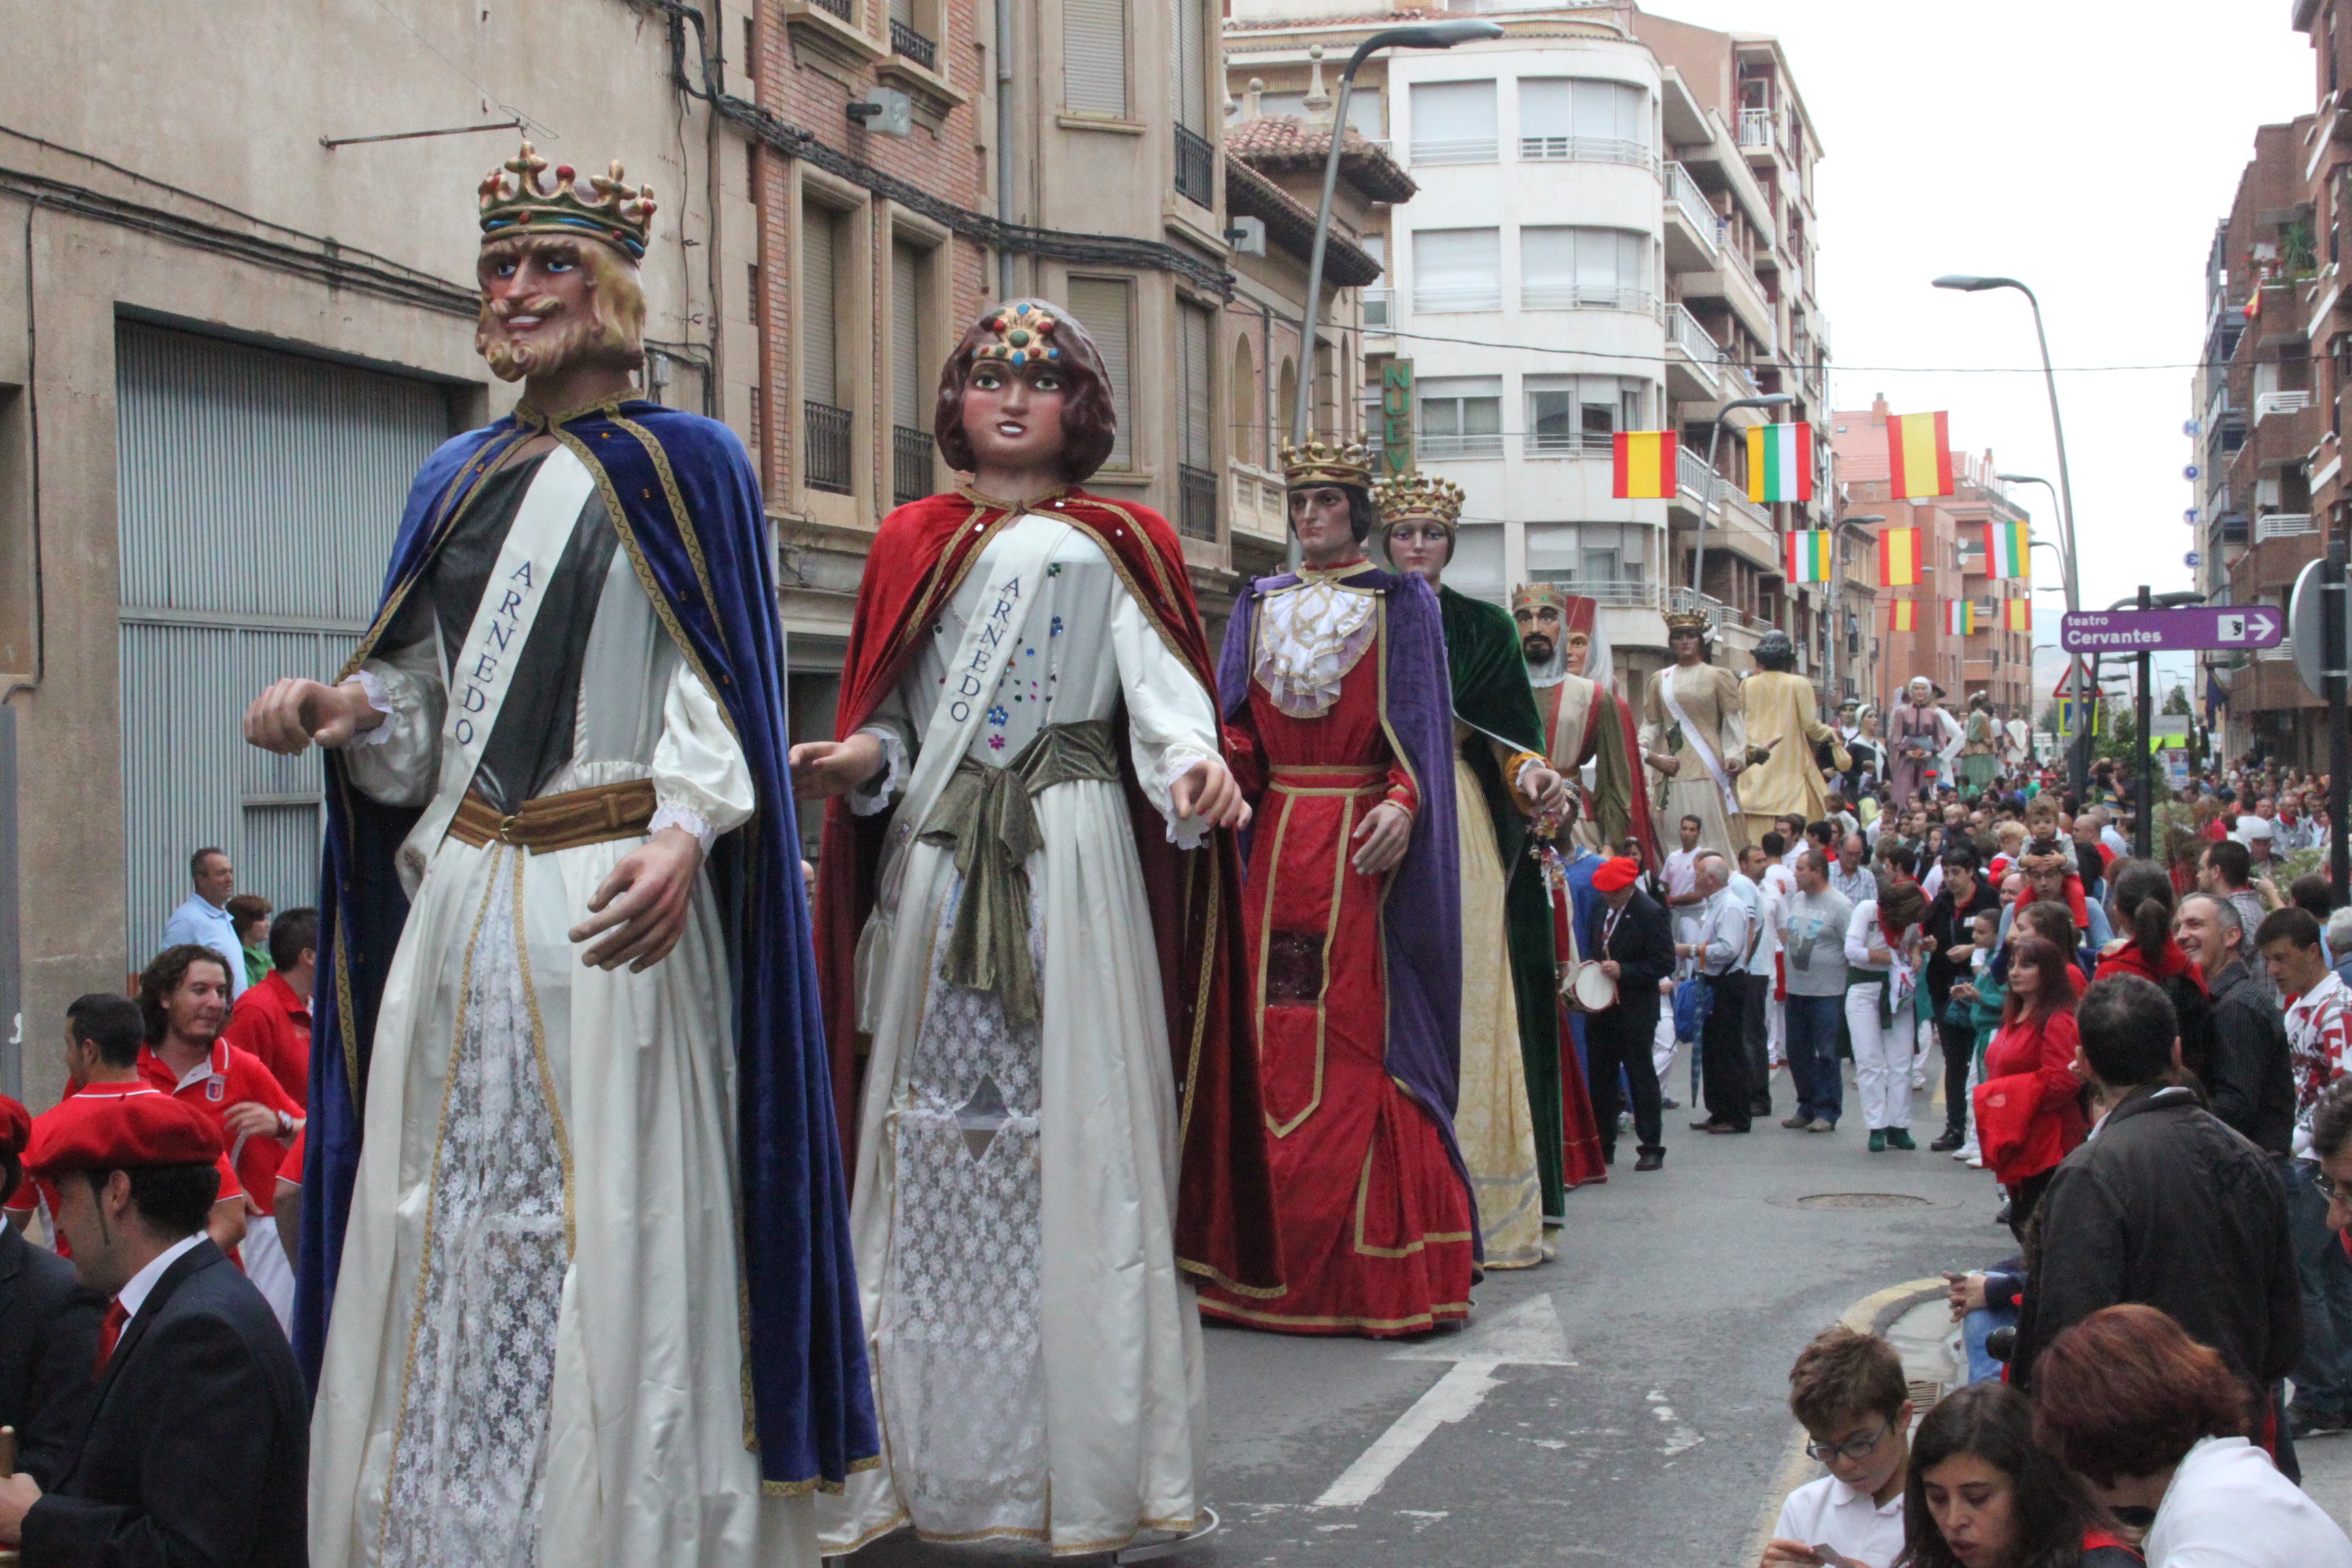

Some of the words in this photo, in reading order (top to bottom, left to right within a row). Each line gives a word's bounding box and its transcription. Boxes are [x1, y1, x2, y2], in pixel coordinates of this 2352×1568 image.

[2185, 419, 2200, 608] HOTE
[455, 561, 534, 745] ARNEDO
[951, 577, 1021, 722] ARNEDO
[2067, 615, 2109, 626] teatro
[2067, 629, 2163, 644] Cervantes
